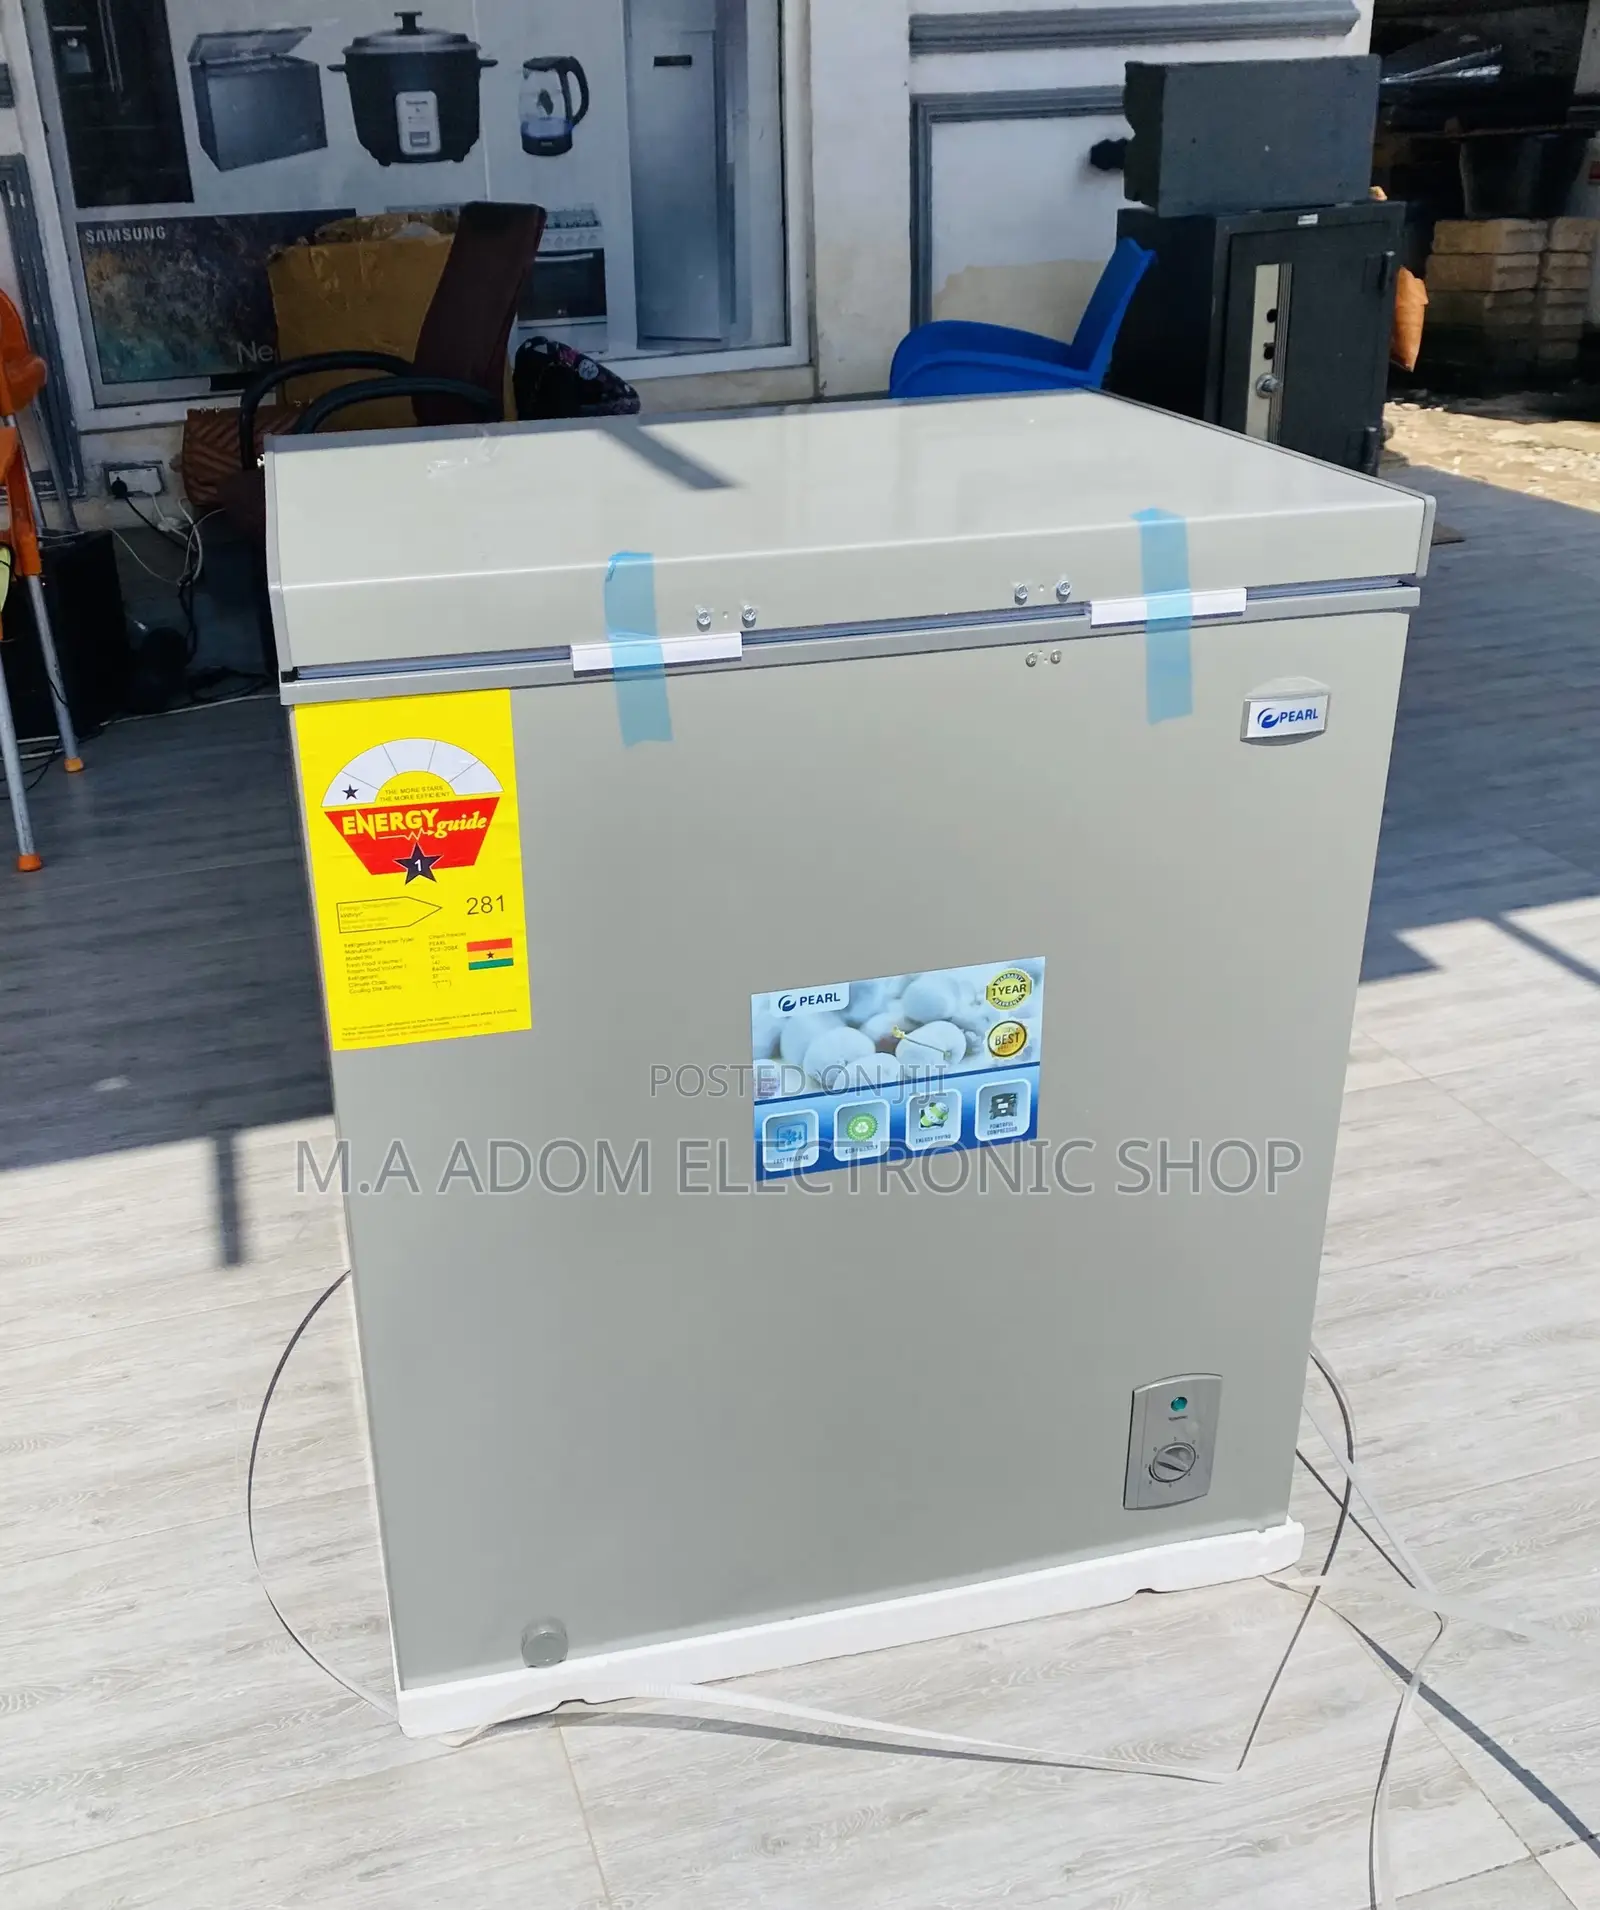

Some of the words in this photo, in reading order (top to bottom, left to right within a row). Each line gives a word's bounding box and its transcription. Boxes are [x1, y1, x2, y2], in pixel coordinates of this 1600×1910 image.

[85, 225, 166, 243] SAMSUNG
[237, 341, 278, 364] Ne
[1280, 708, 1318, 723] PEARL
[341, 809, 439, 841] ENERGY
[434, 811, 487, 839] guide
[414, 859, 422, 872] 1
[466, 894, 504, 916] 281
[991, 988, 996, 997] 1
[998, 983, 1027, 996] YEAR
[800, 992, 841, 1006] PEARL
[995, 1032, 1021, 1046] BEST
